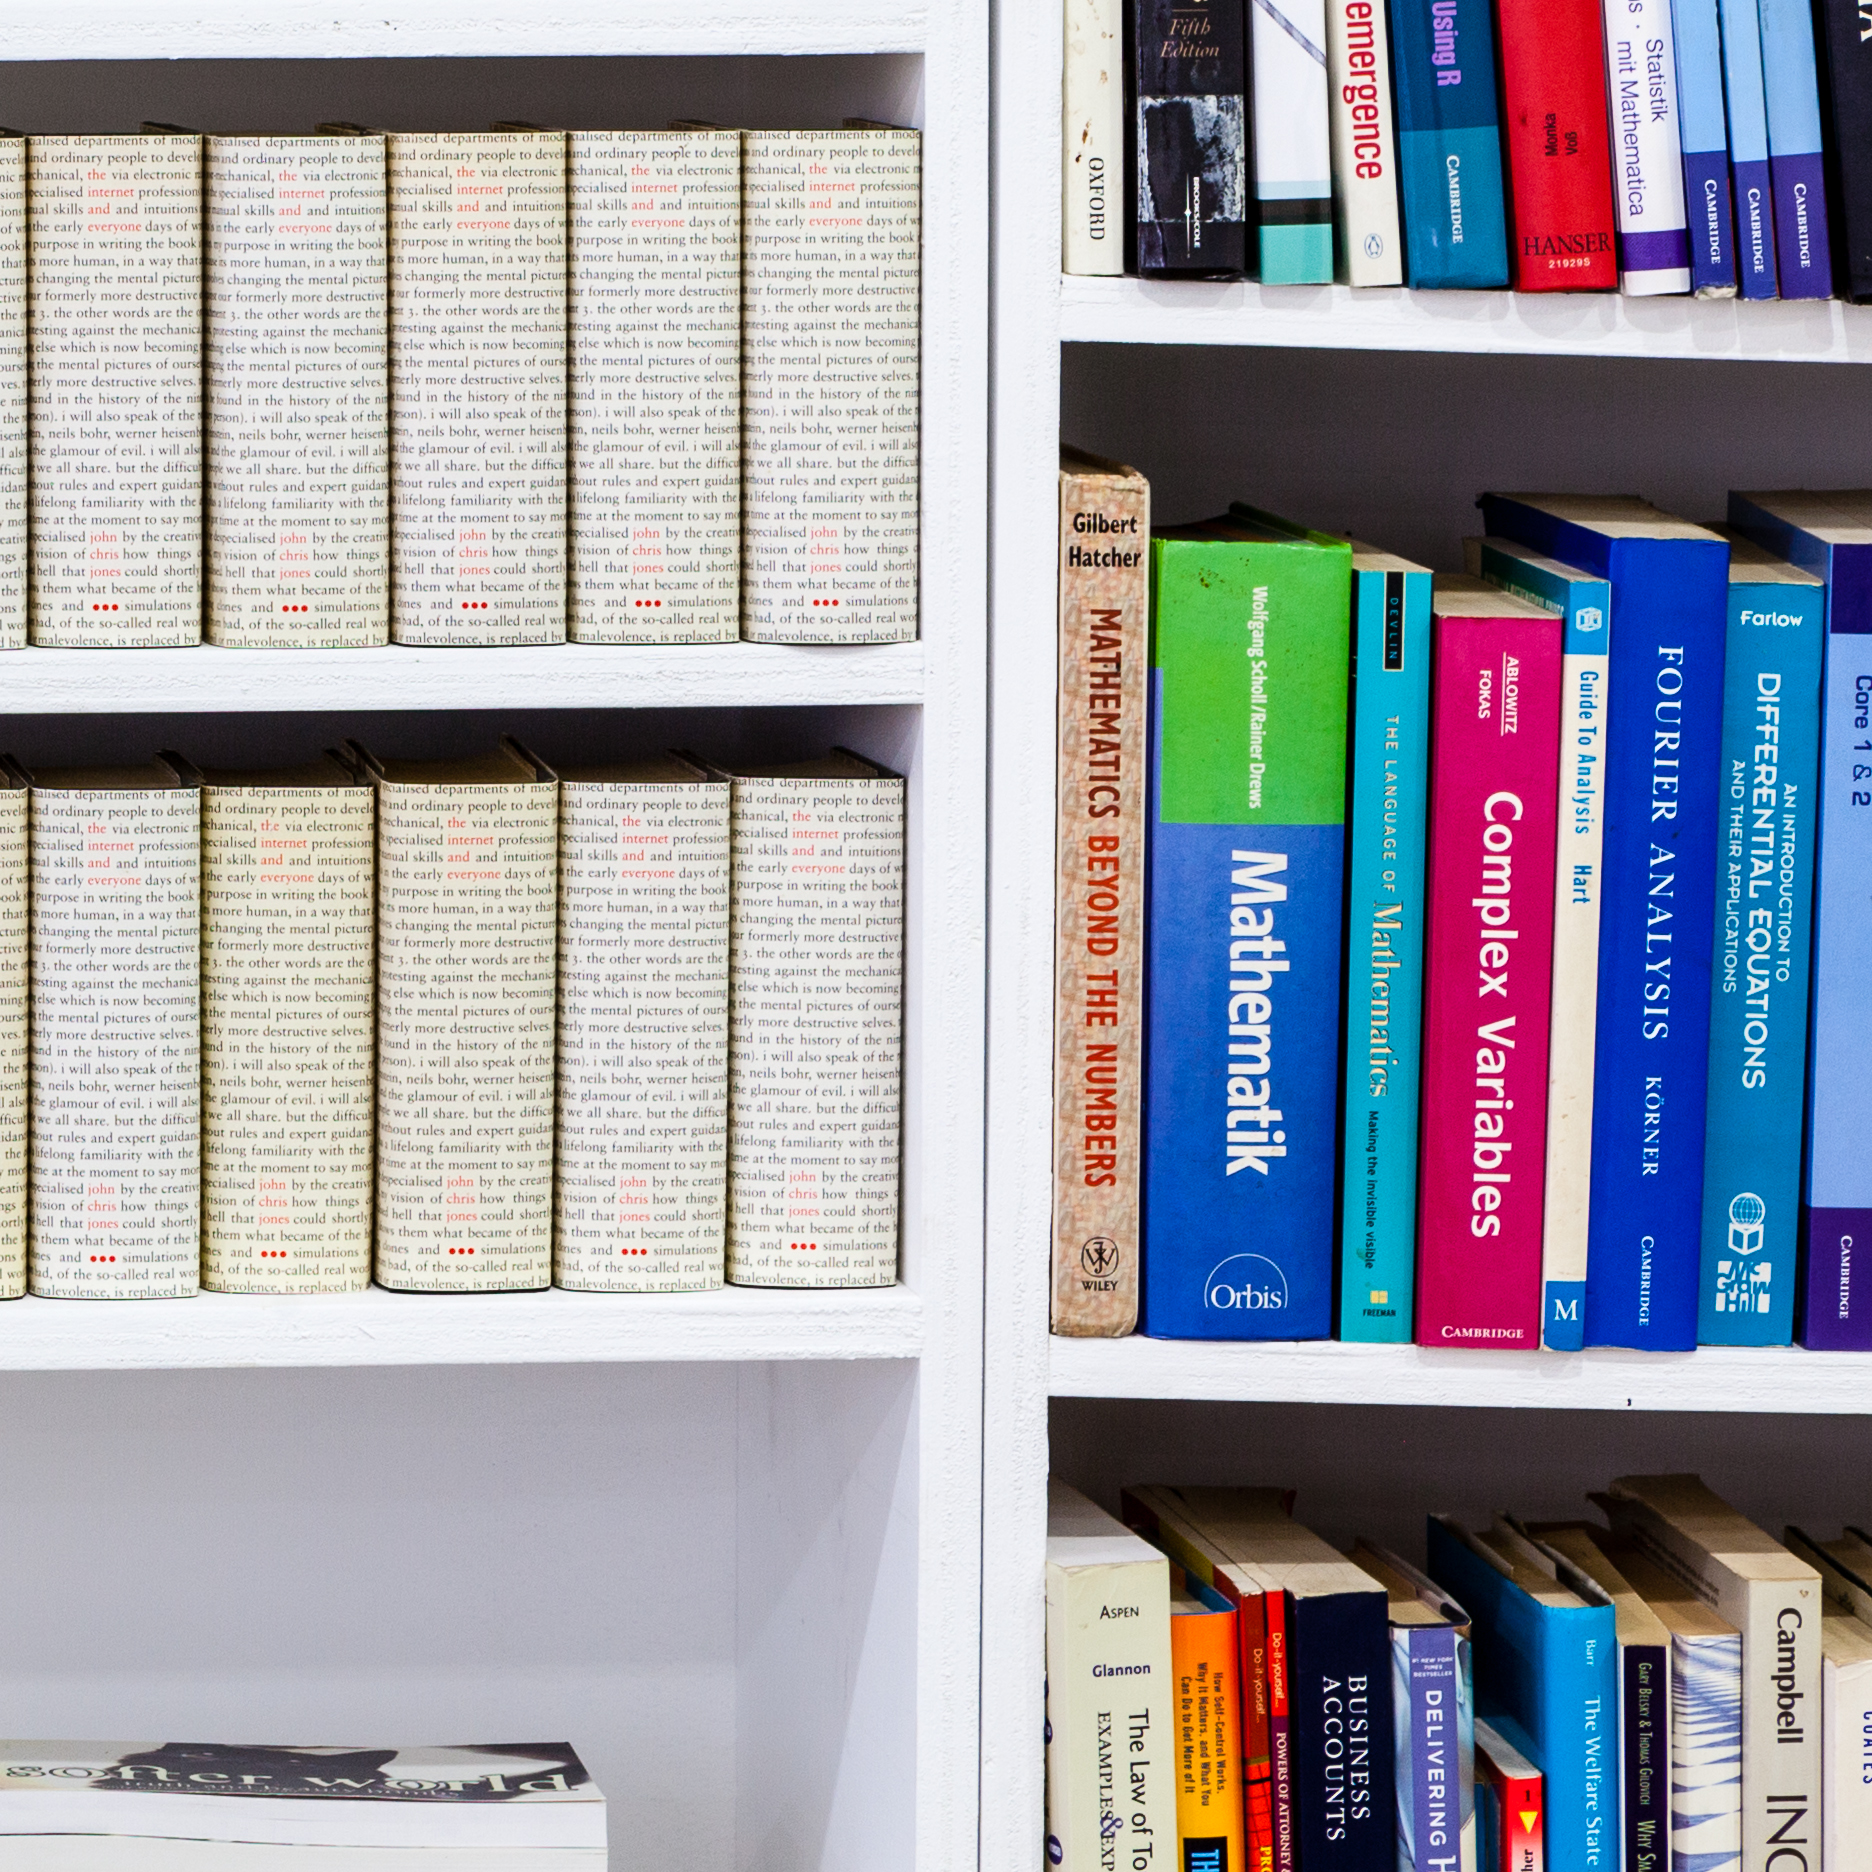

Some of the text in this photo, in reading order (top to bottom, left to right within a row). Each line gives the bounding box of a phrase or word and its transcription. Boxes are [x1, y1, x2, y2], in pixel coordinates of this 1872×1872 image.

[1343, 2, 1382, 179] emergence
[1524, 233, 1611, 256] HANSER
[1073, 512, 1137, 533] Gilbert
[1069, 546, 1141, 568] Hatcher
[1084, 609, 1122, 1187] MATHEMATICS BEYOND THE NUMBERS
[1642, 646, 1683, 1176] FOURIER ANALYSIS KÖRNER
[1226, 850, 1289, 1175] Mathematik
[1471, 792, 1523, 1237] Complex Variables
[619, 1193, 648, 1204] chris
[1082, 1281, 1118, 1291] WILEY
[1211, 1284, 1281, 1309] Orbis
[1442, 1326, 1523, 1338] CAMBRIDGE
[1093, 1664, 1150, 1677] Glannon
[1771, 1608, 1803, 1743] Campbell
[1348, 1675, 1370, 1819] BUSINESS
[5, 1763, 270, 1786] softer
[304, 1772, 579, 1794] world
